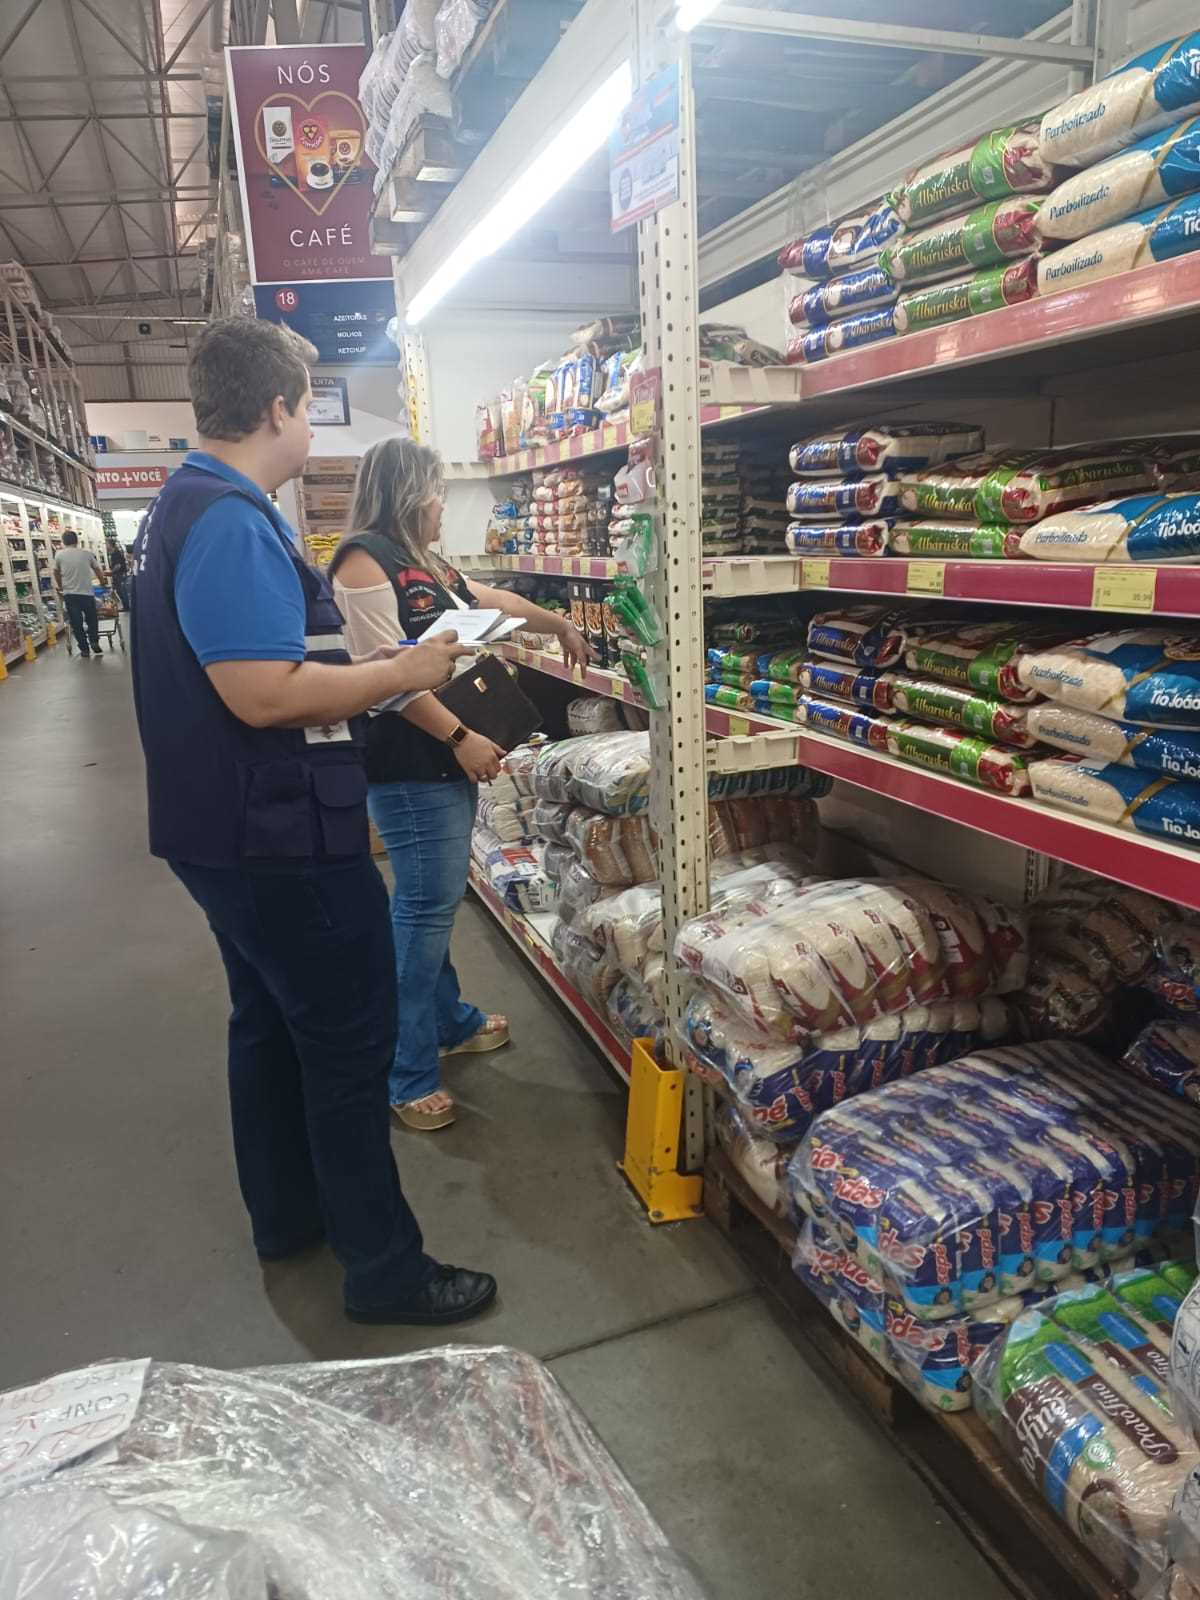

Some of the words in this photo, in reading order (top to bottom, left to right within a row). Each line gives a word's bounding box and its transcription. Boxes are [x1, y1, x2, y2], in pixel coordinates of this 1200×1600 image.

[278, 59, 331, 85] NÓS
[1044, 101, 1106, 142] Parboilizado
[1049, 184, 1111, 220] Parboilizado
[289, 223, 353, 248] CAFÉ
[1046, 250, 1103, 280] Parboilizado
[279, 291, 295, 305] 18
[132, 467, 163, 482] VOCÊ
[1158, 521, 1176, 539] Tio
[915, 536, 971, 552] Albaruska
[1151, 689, 1169, 706] Tio
[1161, 753, 1180, 772] Tio
[1161, 816, 1183, 835] Tio
